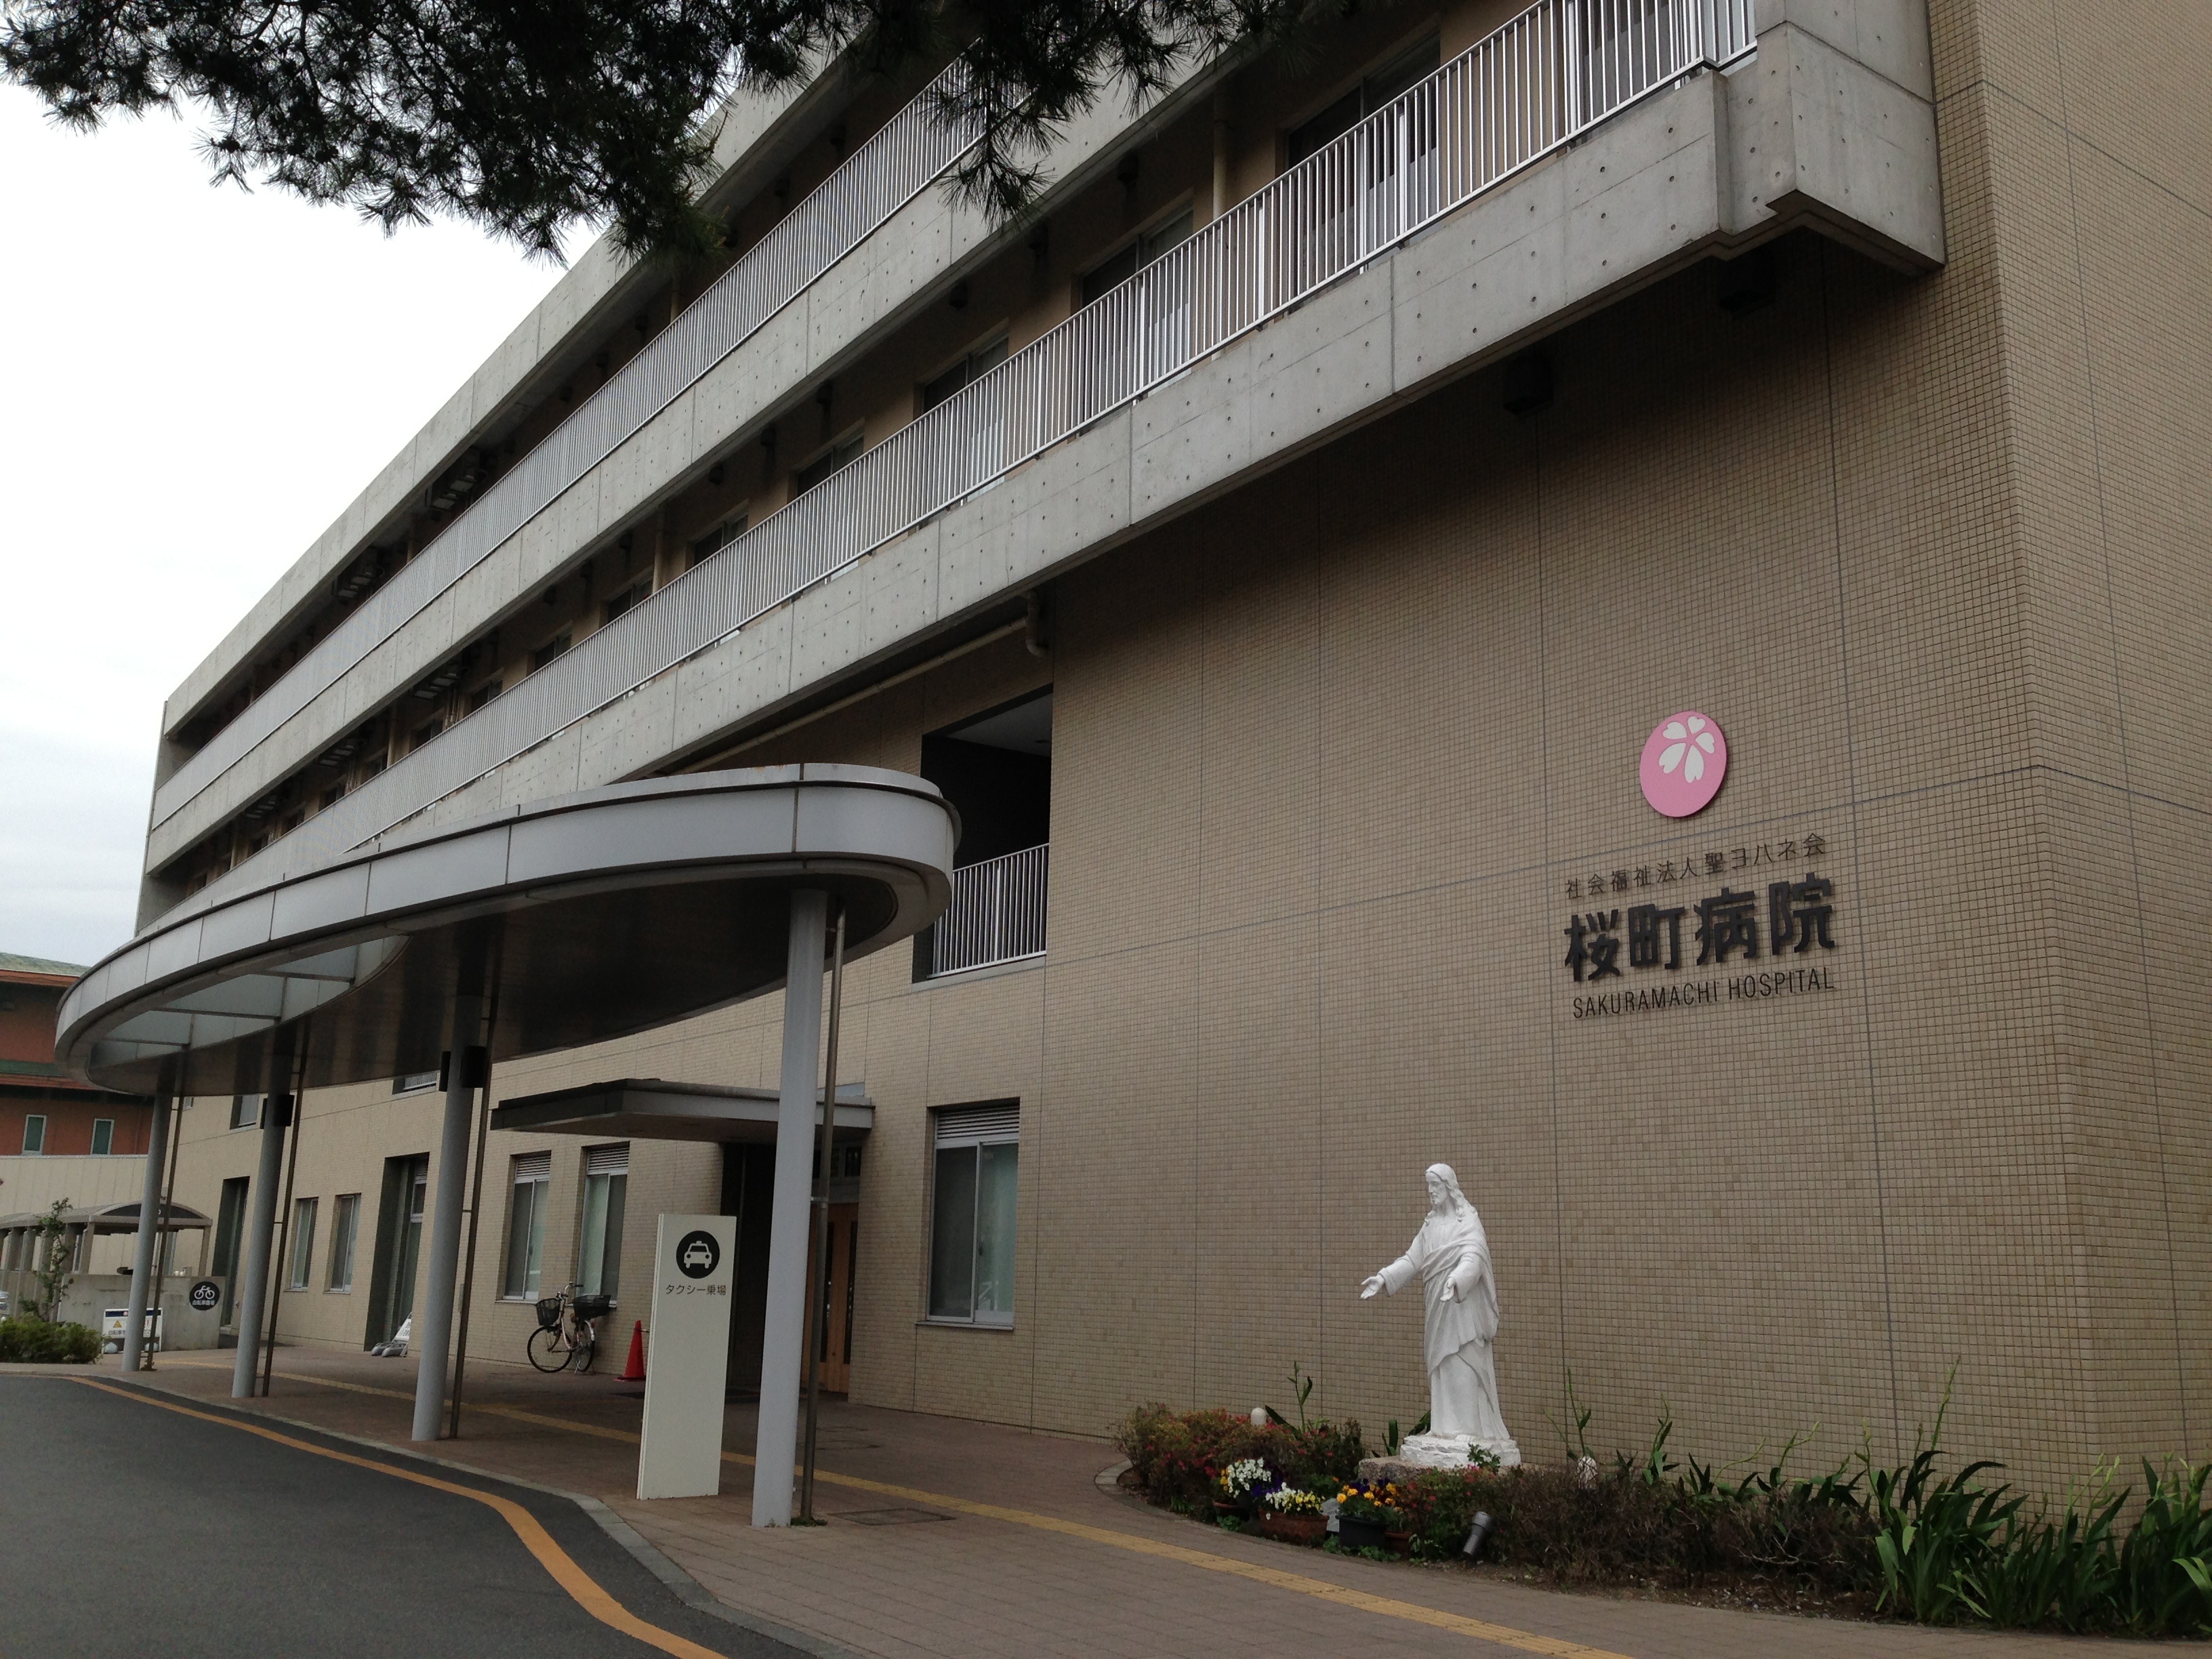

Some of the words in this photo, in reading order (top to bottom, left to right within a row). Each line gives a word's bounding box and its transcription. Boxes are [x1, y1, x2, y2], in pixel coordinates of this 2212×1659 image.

[1565, 832, 1826, 900] 社会福祉法人聖ヨハネ会
[1564, 872, 1835, 982] 桜町病院
[1572, 981, 1718, 1019] SAKURAMACHI
[1728, 967, 1835, 1000] HOSPITAL
[665, 1284, 726, 1296] タクシー乗場
